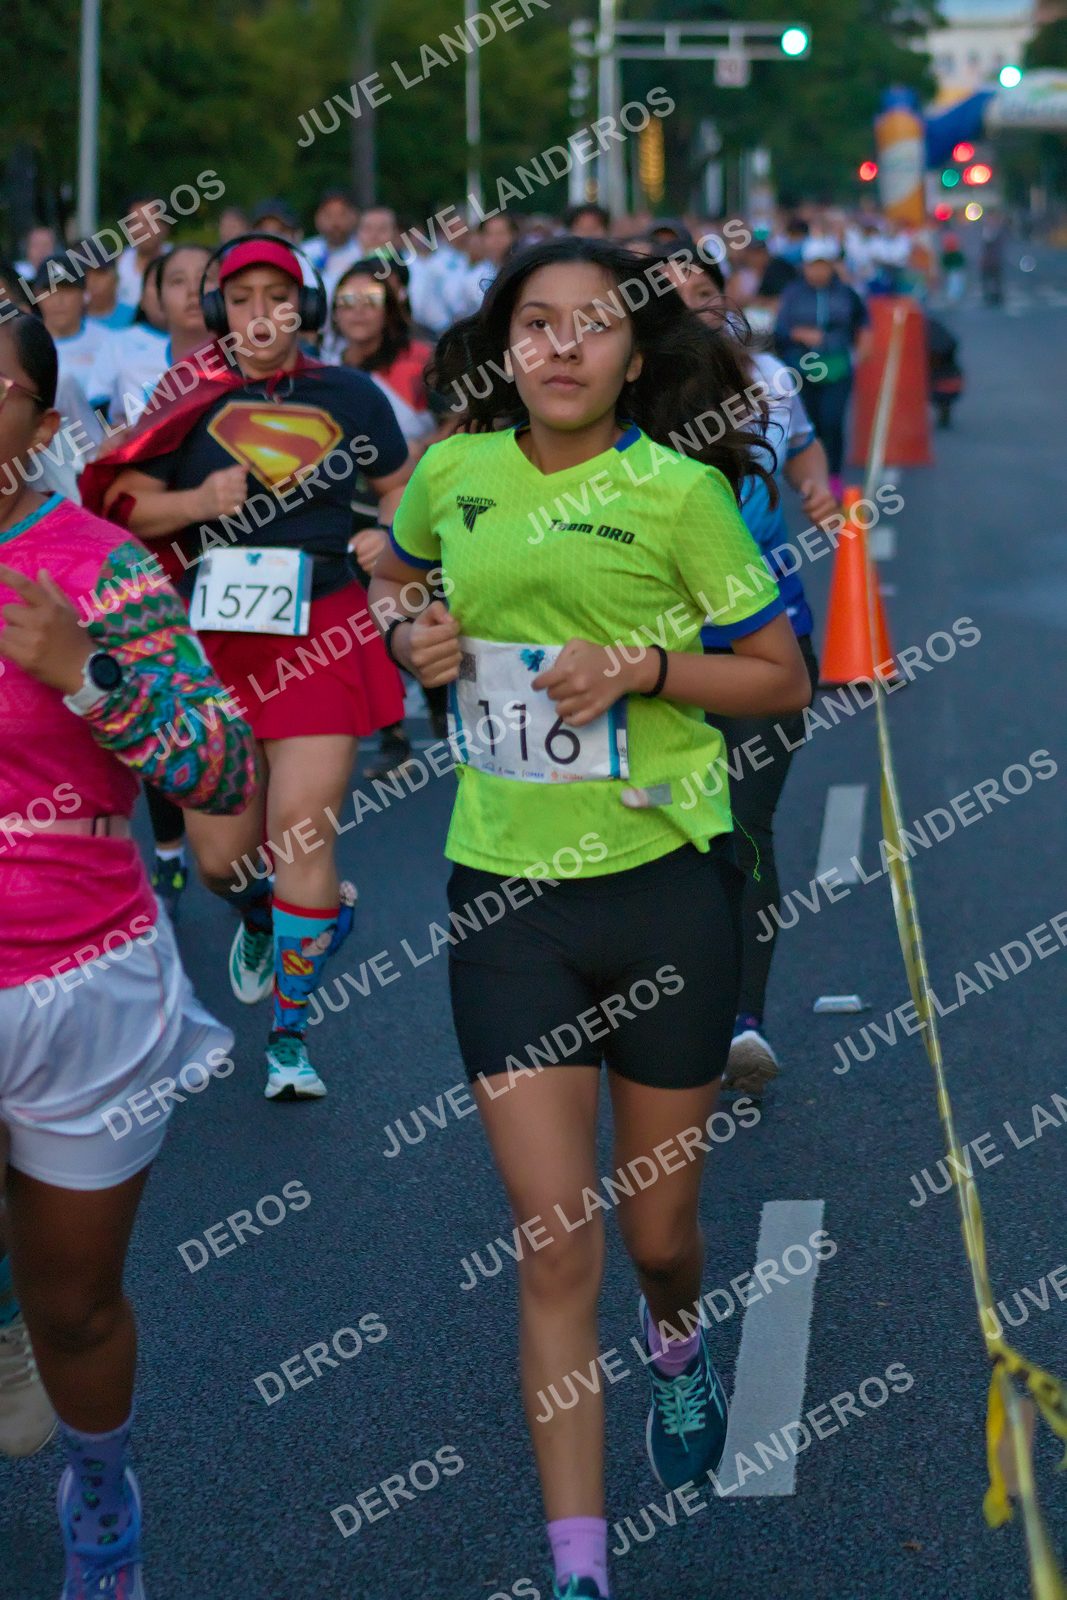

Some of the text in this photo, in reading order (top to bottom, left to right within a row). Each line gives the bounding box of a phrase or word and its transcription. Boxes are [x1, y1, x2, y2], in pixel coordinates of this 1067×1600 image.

[596, 524, 636, 545] ORO
[199, 584, 293, 621] 1572
[477, 699, 581, 765] 116
